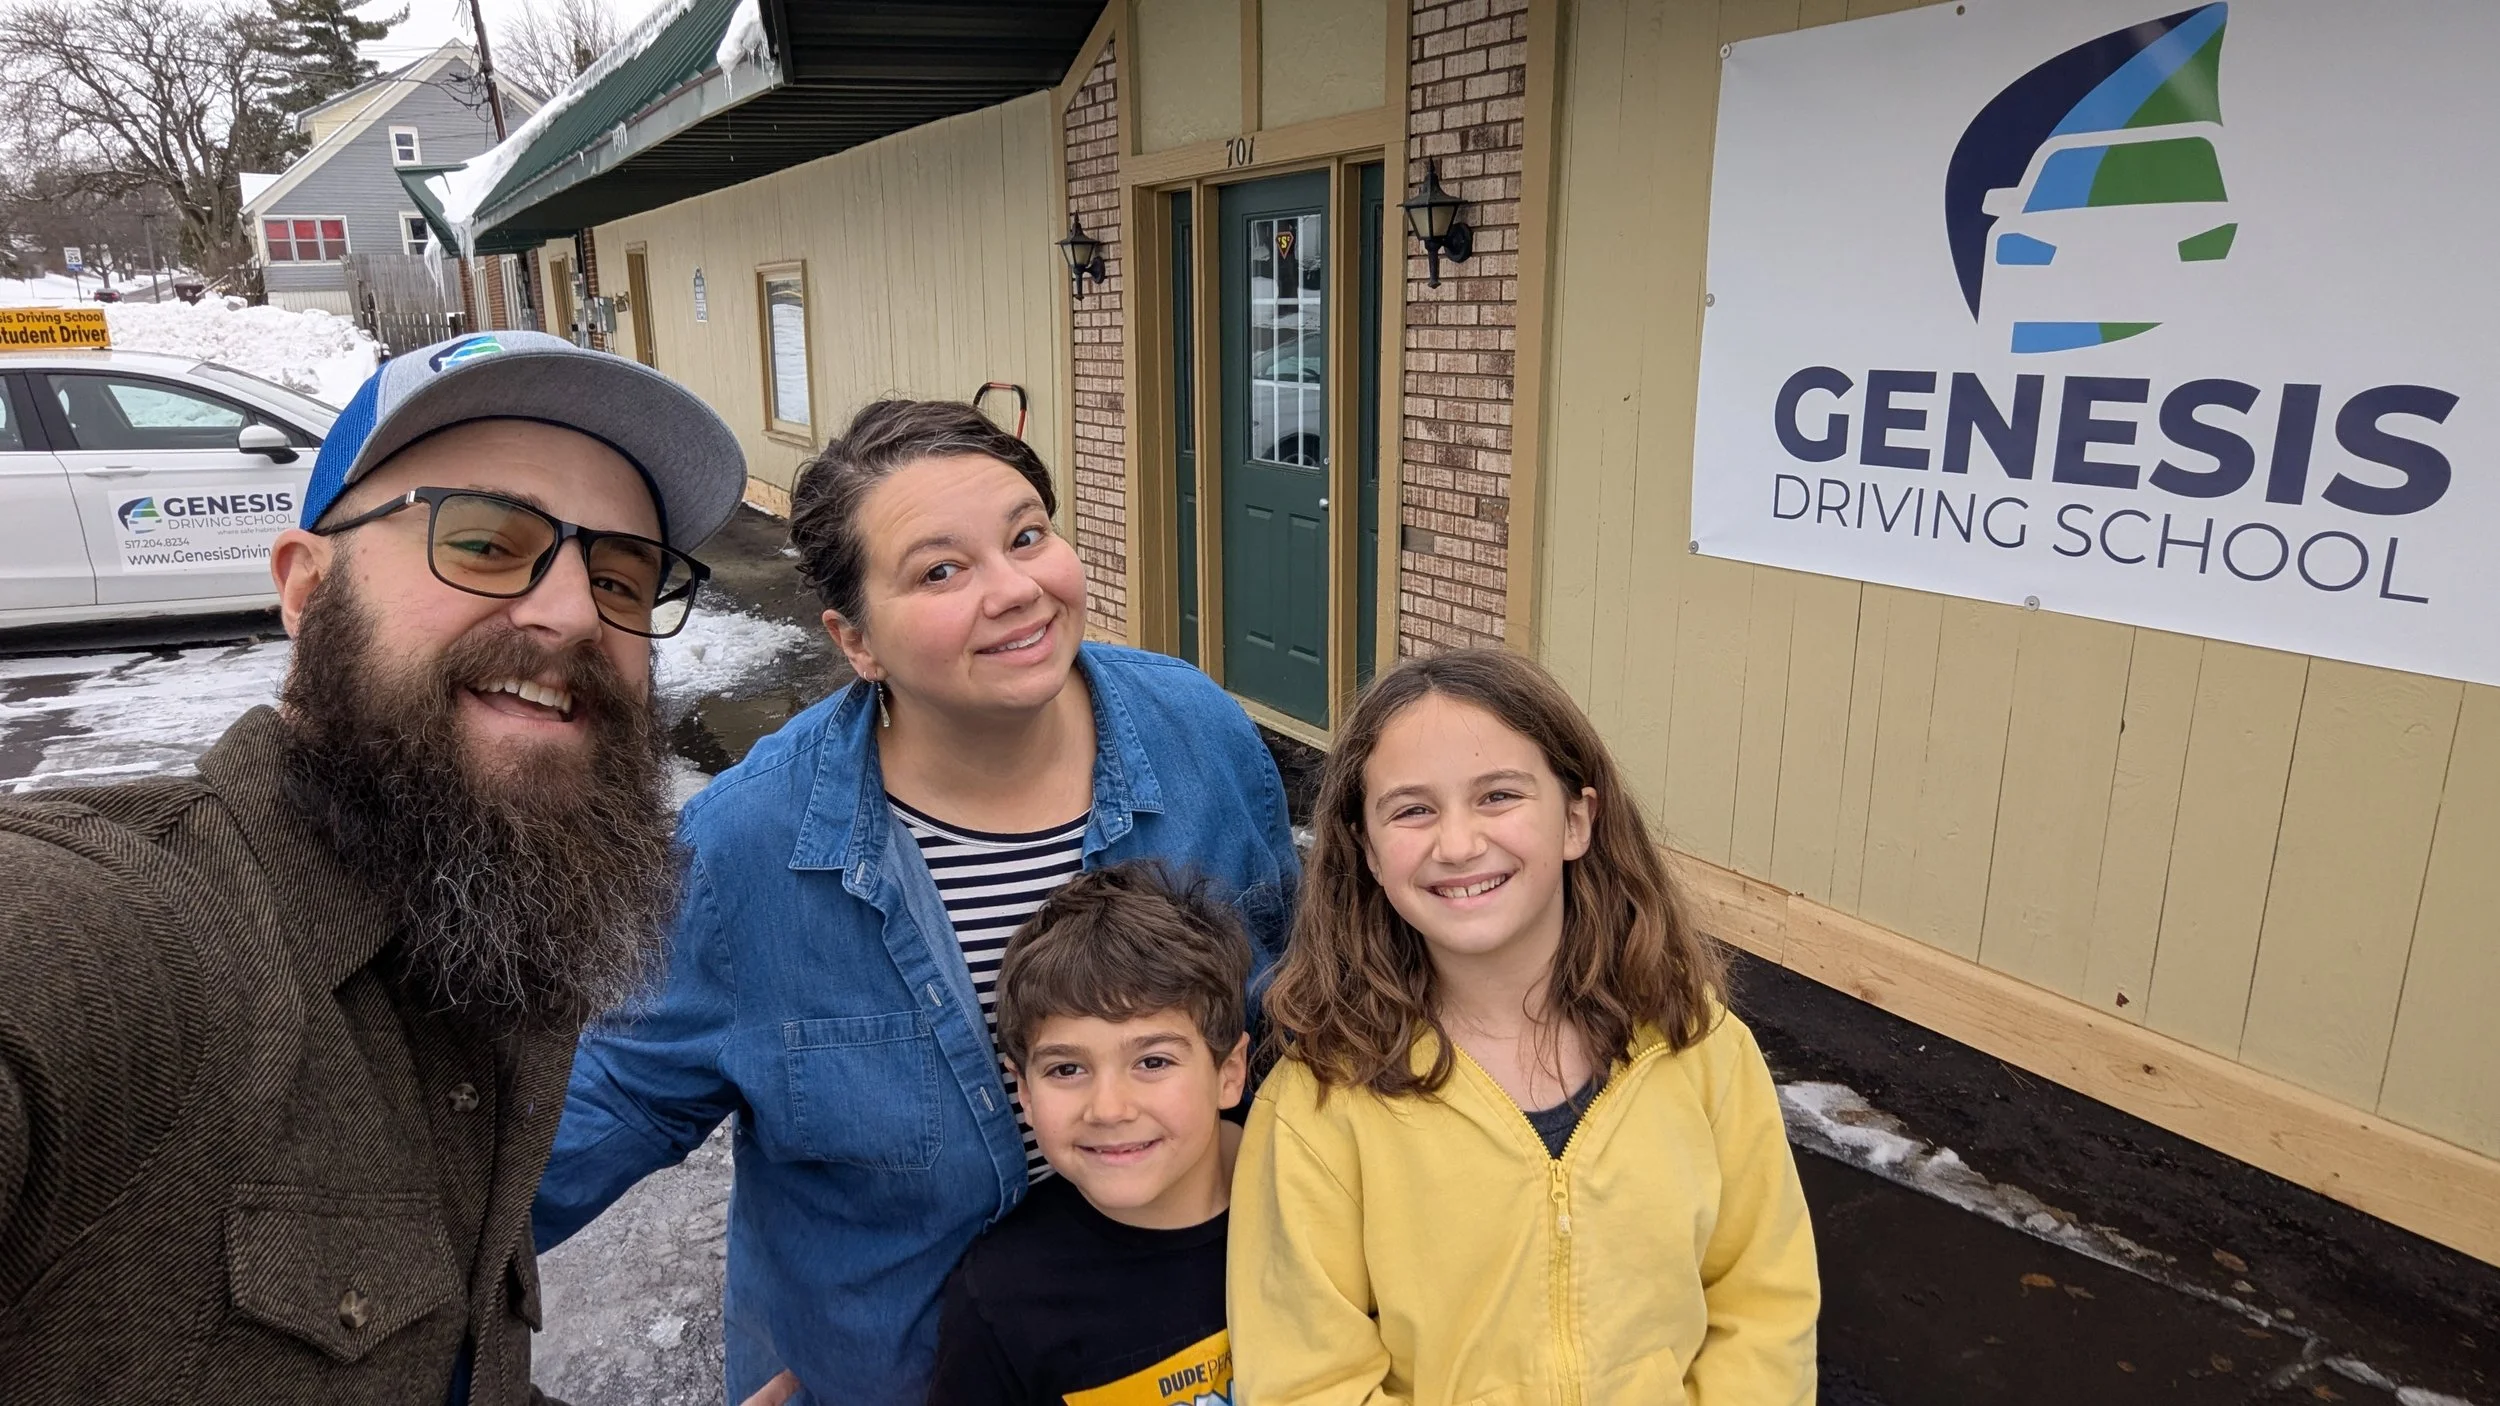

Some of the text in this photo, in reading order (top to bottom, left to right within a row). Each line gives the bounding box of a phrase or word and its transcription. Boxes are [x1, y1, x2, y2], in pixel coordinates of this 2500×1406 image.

[1226, 136, 1255, 168] 701
[16, 312, 61, 324] Driving
[64, 312, 104, 322] School
[0, 325, 106, 344] tudent Driver
[1773, 365, 2461, 516] GENESIS
[163, 492, 293, 517] GENESIS
[168, 513, 296, 530] DRIVING SCHOOL
[124, 537, 190, 549] 517.204.8234
[1772, 473, 2430, 604] DRIVING SCHOOL
[127, 544, 271, 566] www.GenesisDrivin
[1158, 1352, 1232, 1398] DUDE PER
